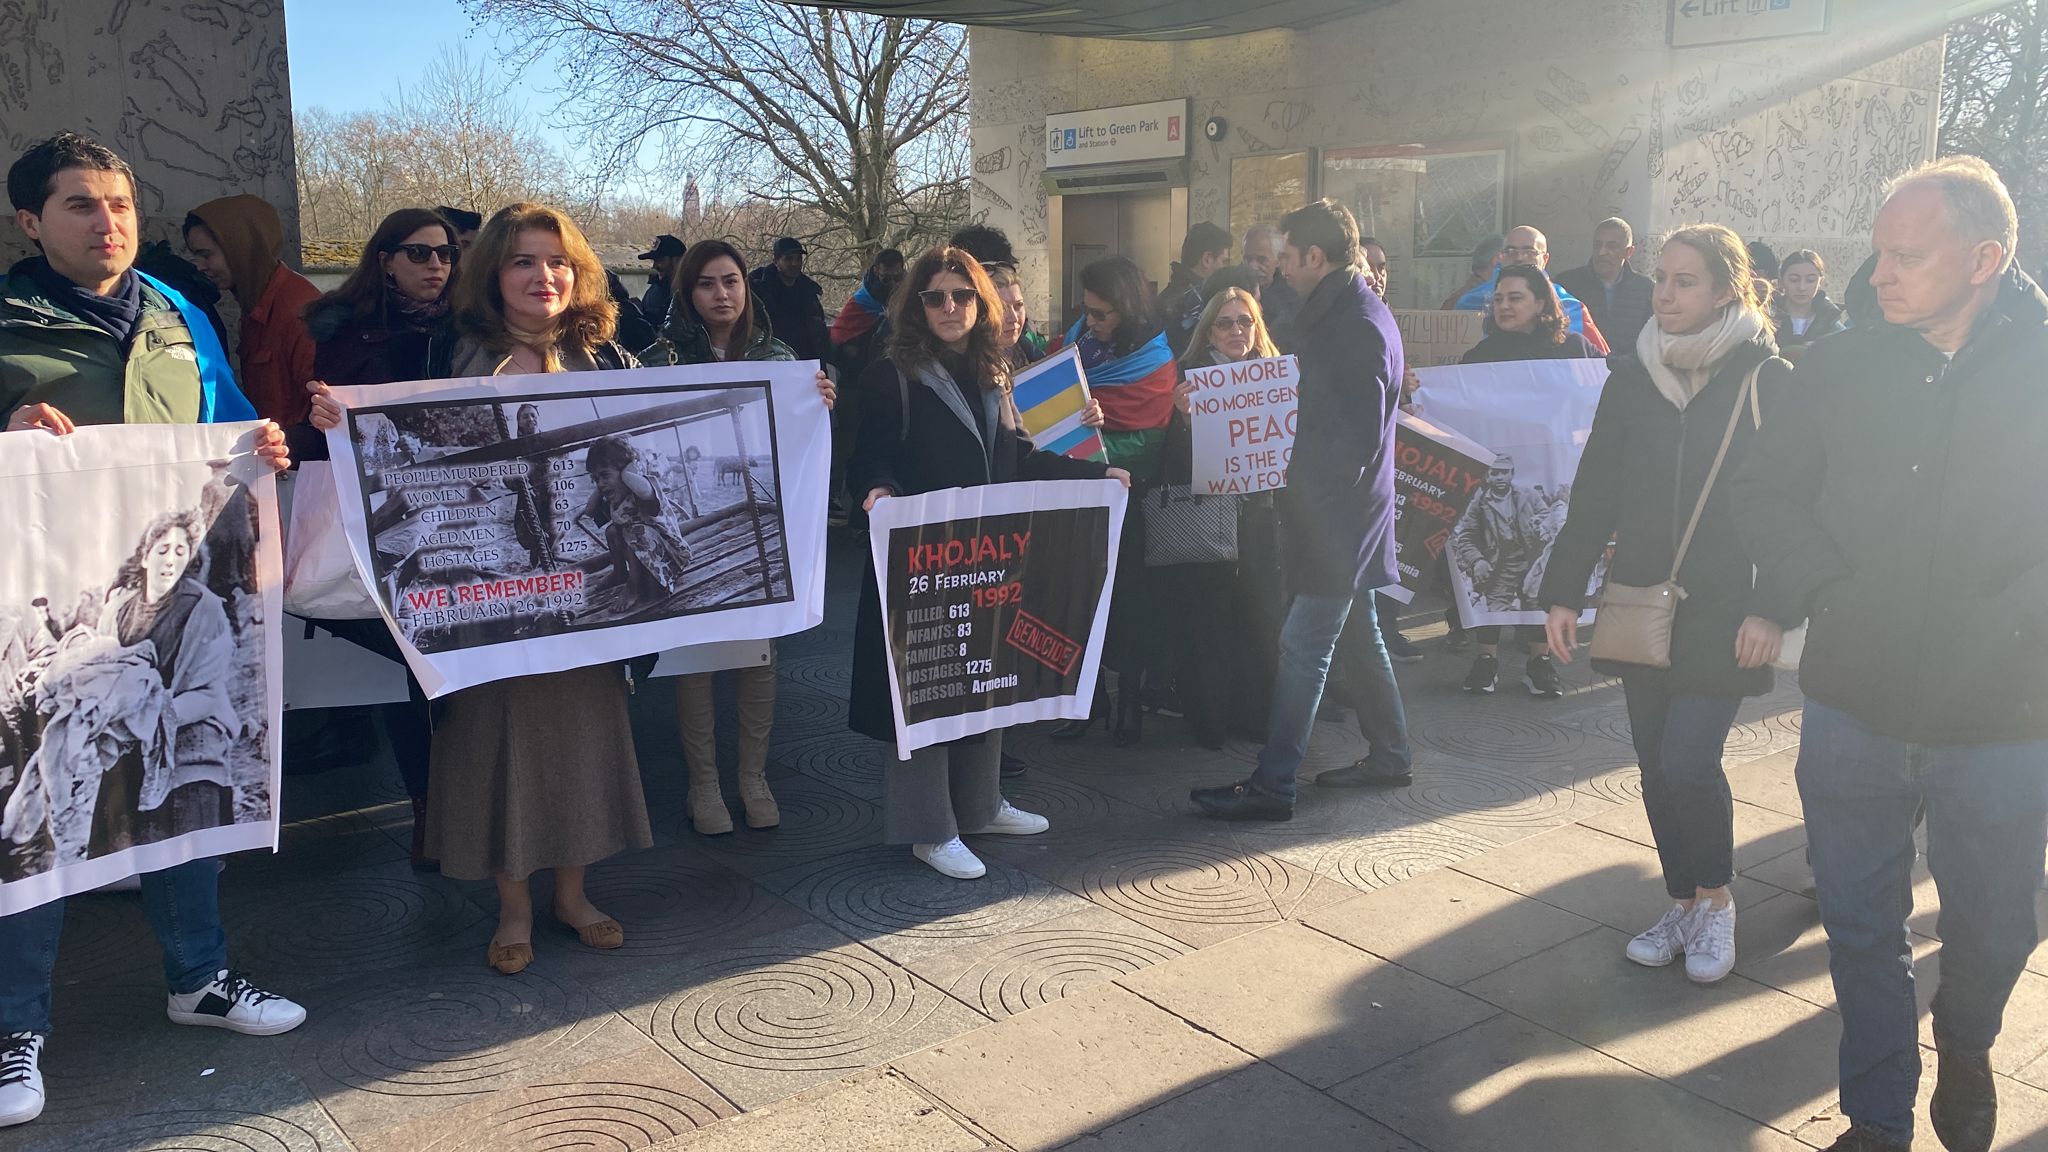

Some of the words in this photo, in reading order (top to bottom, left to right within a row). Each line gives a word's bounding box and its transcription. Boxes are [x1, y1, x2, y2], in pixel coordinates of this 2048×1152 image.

[1702, 0, 1738, 16] Lift
[1078, 126, 1094, 138] Lift
[1097, 125, 1106, 136] to
[1109, 122, 1136, 136] Green
[1139, 120, 1159, 132] Park
[1169, 125, 1178, 138] A
[1089, 139, 1109, 148] Station
[1436, 314, 1471, 344] 1992
[1193, 369, 1225, 391] NO
[1231, 359, 1289, 386] MORE
[1195, 398, 1220, 416] NO
[1222, 390, 1264, 412] MORE
[1267, 385, 1299, 404] GEN
[1228, 409, 1298, 448] PEAC
[384, 470, 438, 486] PEOPLE
[442, 463, 529, 480] MURDERED
[553, 459, 575, 472] 613
[1225, 456, 1241, 474] IS
[1245, 450, 1277, 470] THE
[406, 488, 466, 504] WOMEN
[554, 480, 575, 492] 106
[1208, 476, 1252, 494] WAY
[420, 506, 498, 524] CHILDREN
[554, 500, 569, 511] 63
[1411, 491, 1457, 523] 1992
[418, 532, 458, 546] AGED
[462, 528, 496, 543] MEN
[556, 520, 571, 532] 70
[424, 550, 499, 568] HOSTAGES
[559, 540, 588, 553] 1275
[907, 531, 1032, 573] KHOJALY
[408, 588, 448, 611] WE
[457, 572, 584, 604] REMEMBER!
[908, 576, 929, 596] 26
[973, 582, 1022, 609] 1992
[412, 602, 511, 628] FEBRUARY
[516, 600, 535, 614] 26
[546, 594, 584, 609] 1992
[906, 606, 945, 625] KILLED:
[948, 602, 970, 619] 613
[906, 624, 955, 646] INFANTS:
[957, 622, 972, 637] 83
[1012, 618, 1074, 668] GENOCIDE
[905, 645, 958, 667] FAMILIES:
[960, 642, 967, 657] 8
[966, 658, 992, 675] 1275
[972, 674, 1018, 694] Armenia
